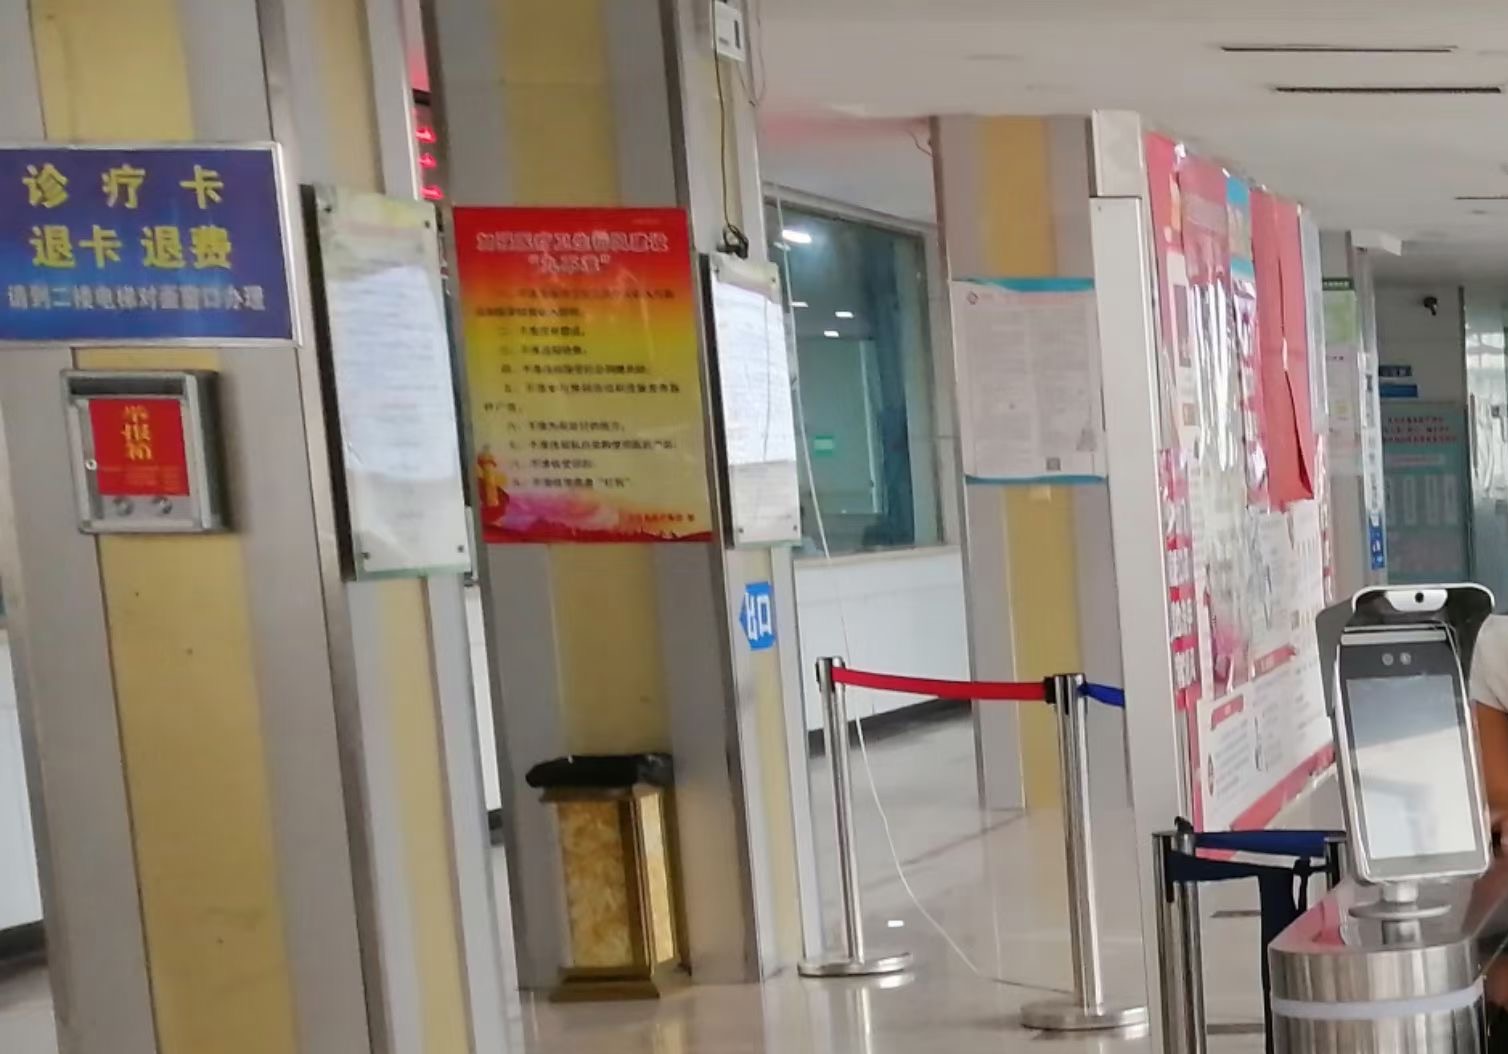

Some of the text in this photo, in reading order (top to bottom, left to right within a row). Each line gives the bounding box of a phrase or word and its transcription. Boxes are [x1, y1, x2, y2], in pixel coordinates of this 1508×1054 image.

[22, 163, 224, 209] 诊疗卡
[30, 225, 232, 269] 退卡 退费
